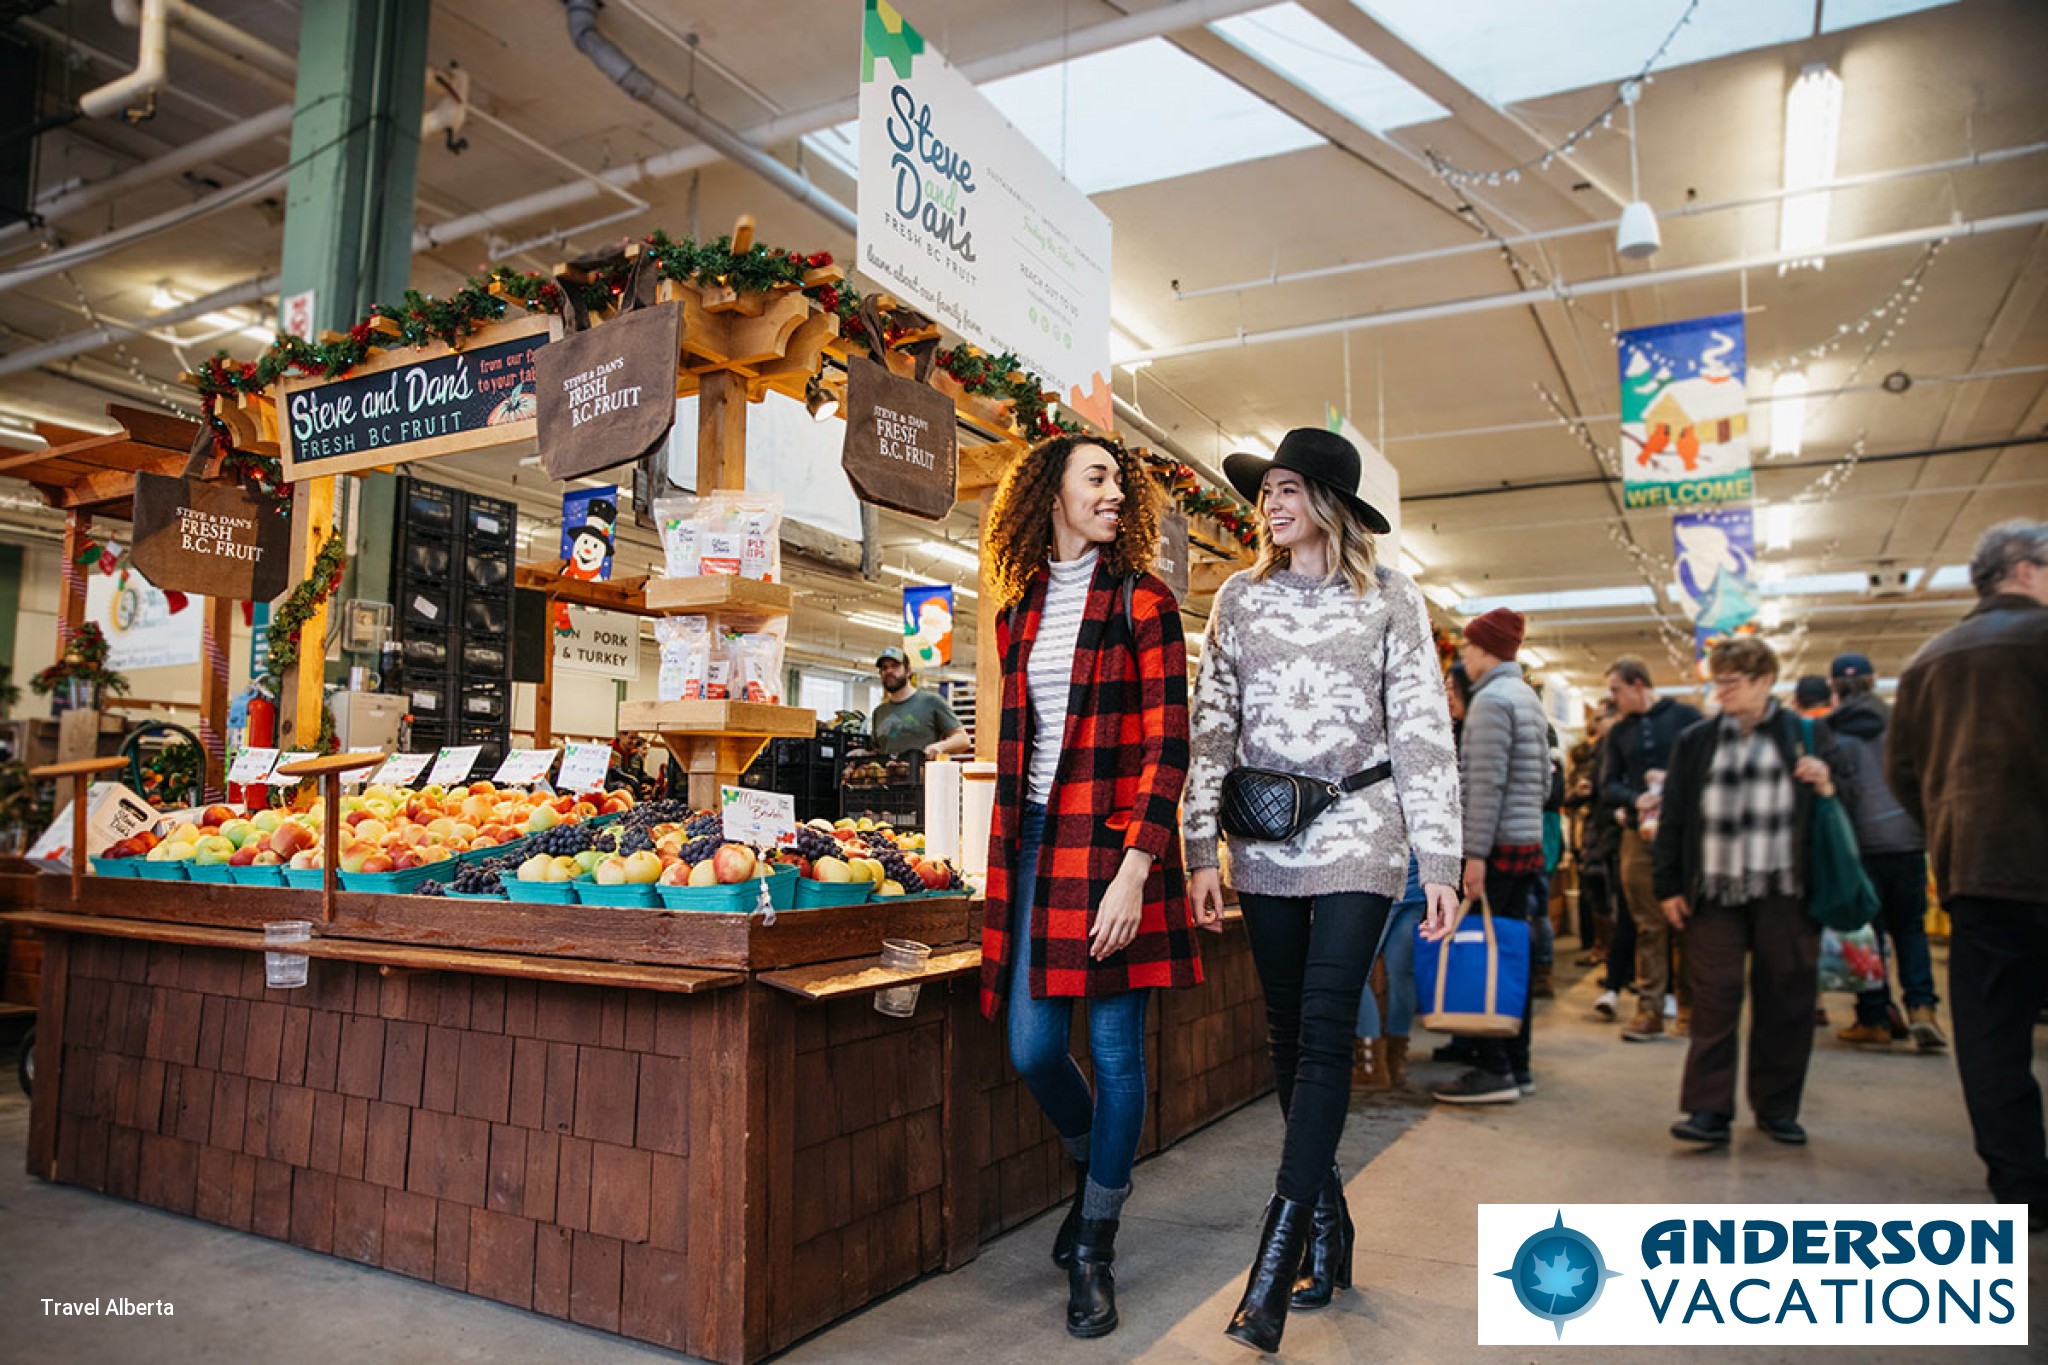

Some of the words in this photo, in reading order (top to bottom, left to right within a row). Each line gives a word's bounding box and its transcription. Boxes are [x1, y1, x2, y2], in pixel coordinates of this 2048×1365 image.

[887, 85, 976, 193] Steve
[891, 153, 976, 262] Dan's
[924, 179, 958, 216] and
[884, 212, 922, 249] FRESH
[927, 243, 941, 263] BC
[945, 256, 977, 287] FRUIT
[867, 244, 892, 275] learn
[893, 264, 919, 293] about
[937, 291, 961, 328] family
[480, 359, 503, 374] from
[506, 352, 522, 367] our
[478, 378, 490, 393] to
[491, 373, 516, 395] your
[519, 366, 536, 383] tab
[569, 376, 608, 408] FRESH
[291, 394, 358, 441] Steve
[361, 371, 400, 419] and
[405, 354, 474, 414] Dan's
[594, 386, 642, 416] FRUIT
[301, 433, 356, 459] FRESH
[368, 425, 392, 447] BC
[400, 411, 462, 442] FRUIT
[877, 418, 917, 445] FRESH
[880, 437, 903, 460] B.C.
[905, 445, 935, 471] FRUIT
[1628, 477, 1751, 506] WELCOME
[176, 506, 207, 521] STEVE
[209, 515, 217, 523] &
[220, 516, 252, 530] DAN'S
[180, 518, 233, 541] FRESH
[182, 534, 211, 554] B.C.
[215, 541, 264, 562] FRUIT
[593, 630, 628, 648] PORK
[562, 646, 571, 659] &
[577, 648, 628, 667] TURKEY
